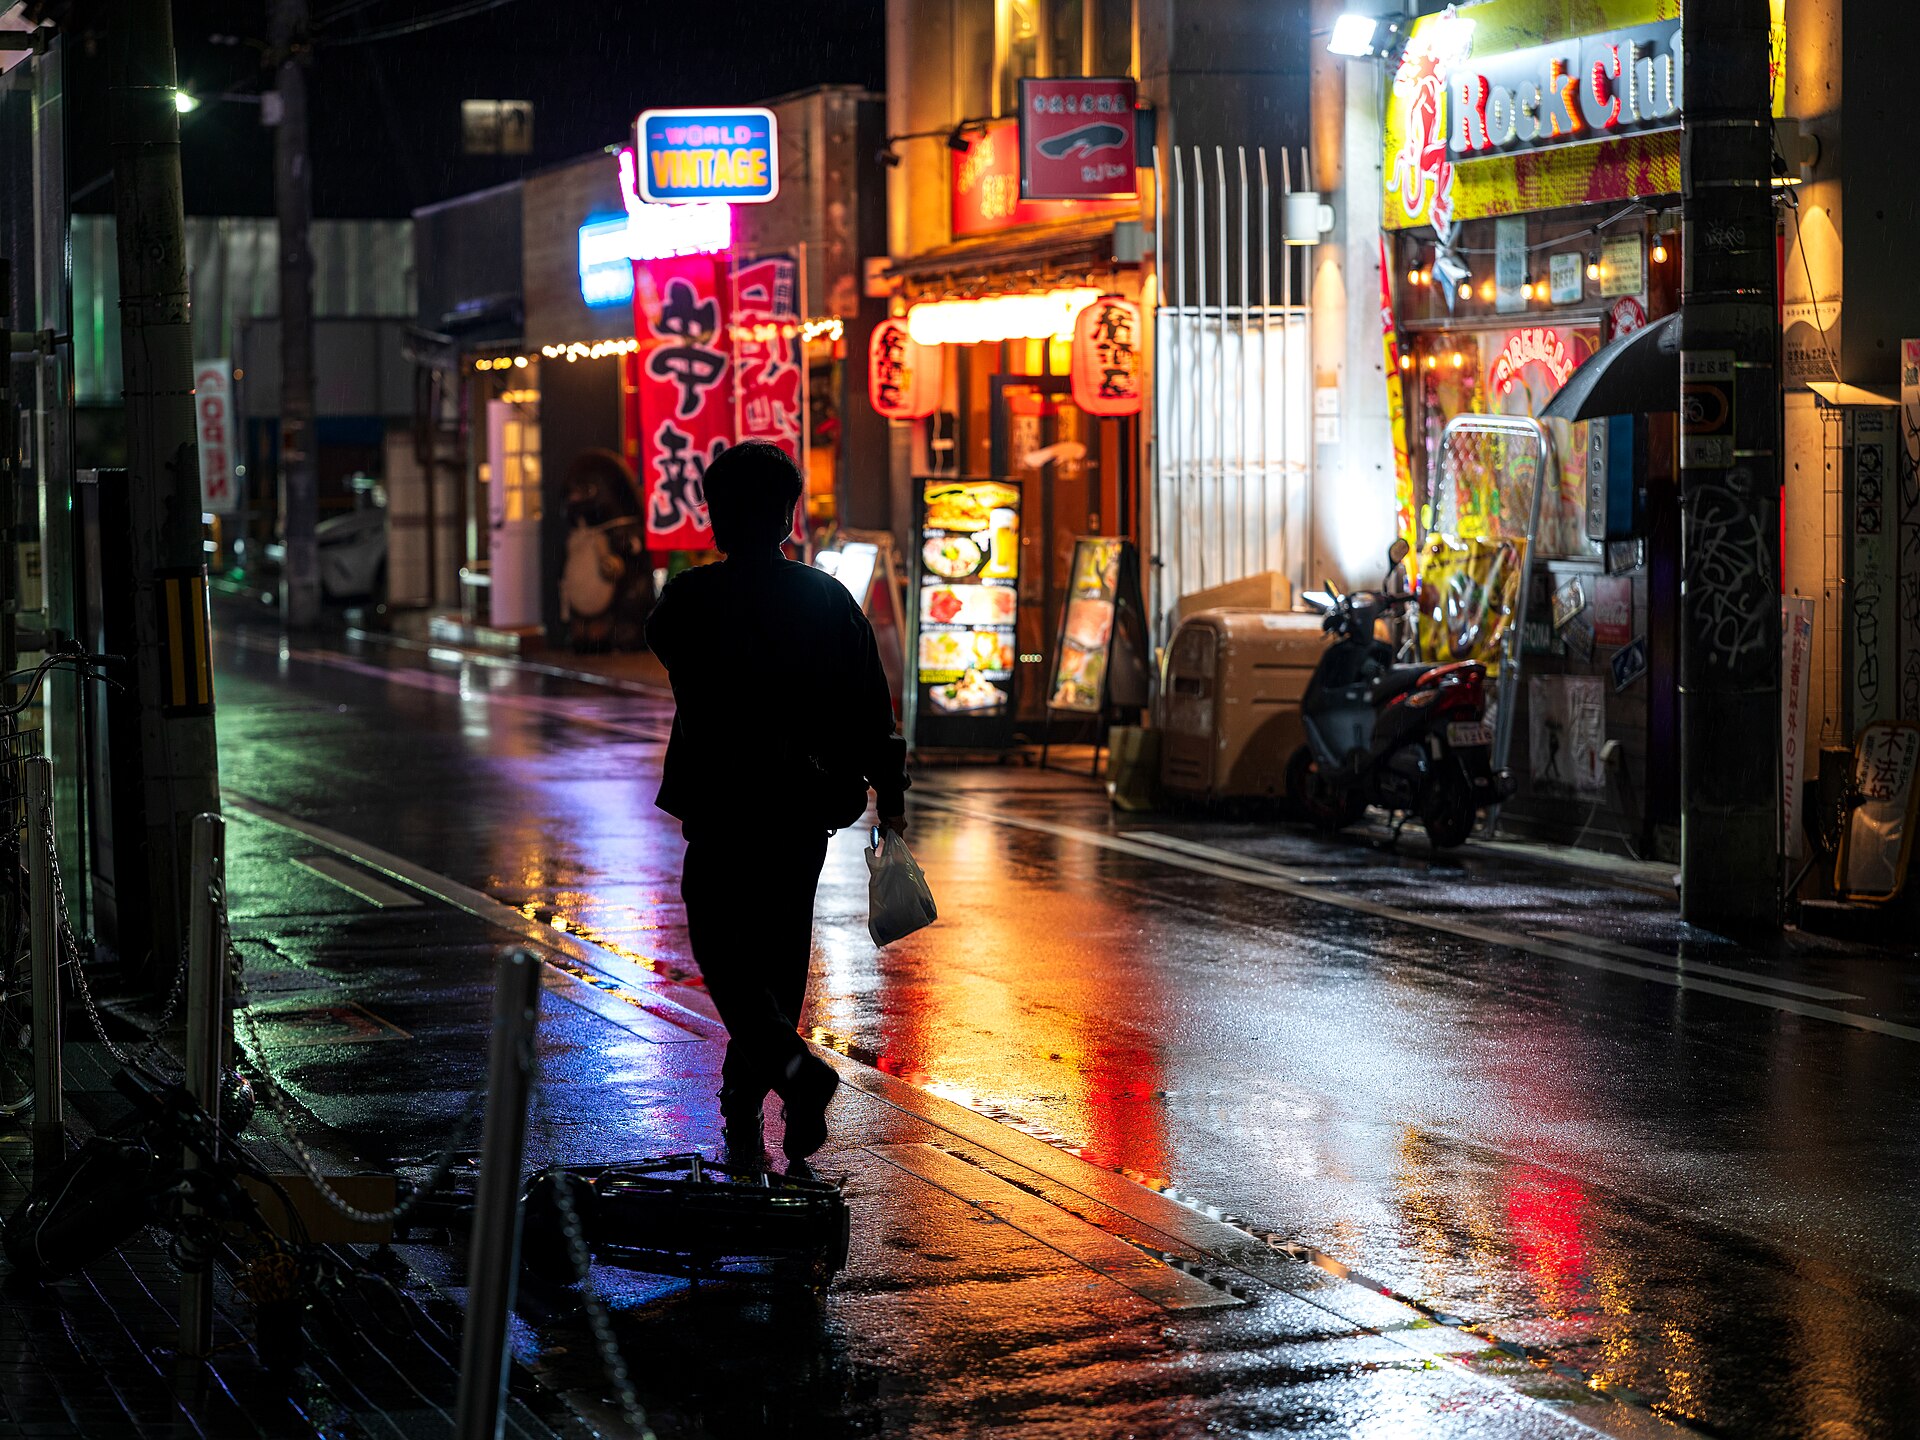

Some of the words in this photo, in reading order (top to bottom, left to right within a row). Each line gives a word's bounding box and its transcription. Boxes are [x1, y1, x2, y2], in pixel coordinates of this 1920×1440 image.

[1449, 58, 1579, 153] Rock
[1580, 29, 1682, 129] Clu
[664, 125, 752, 147] WORLD
[650, 148, 769, 189] VINTAGE
